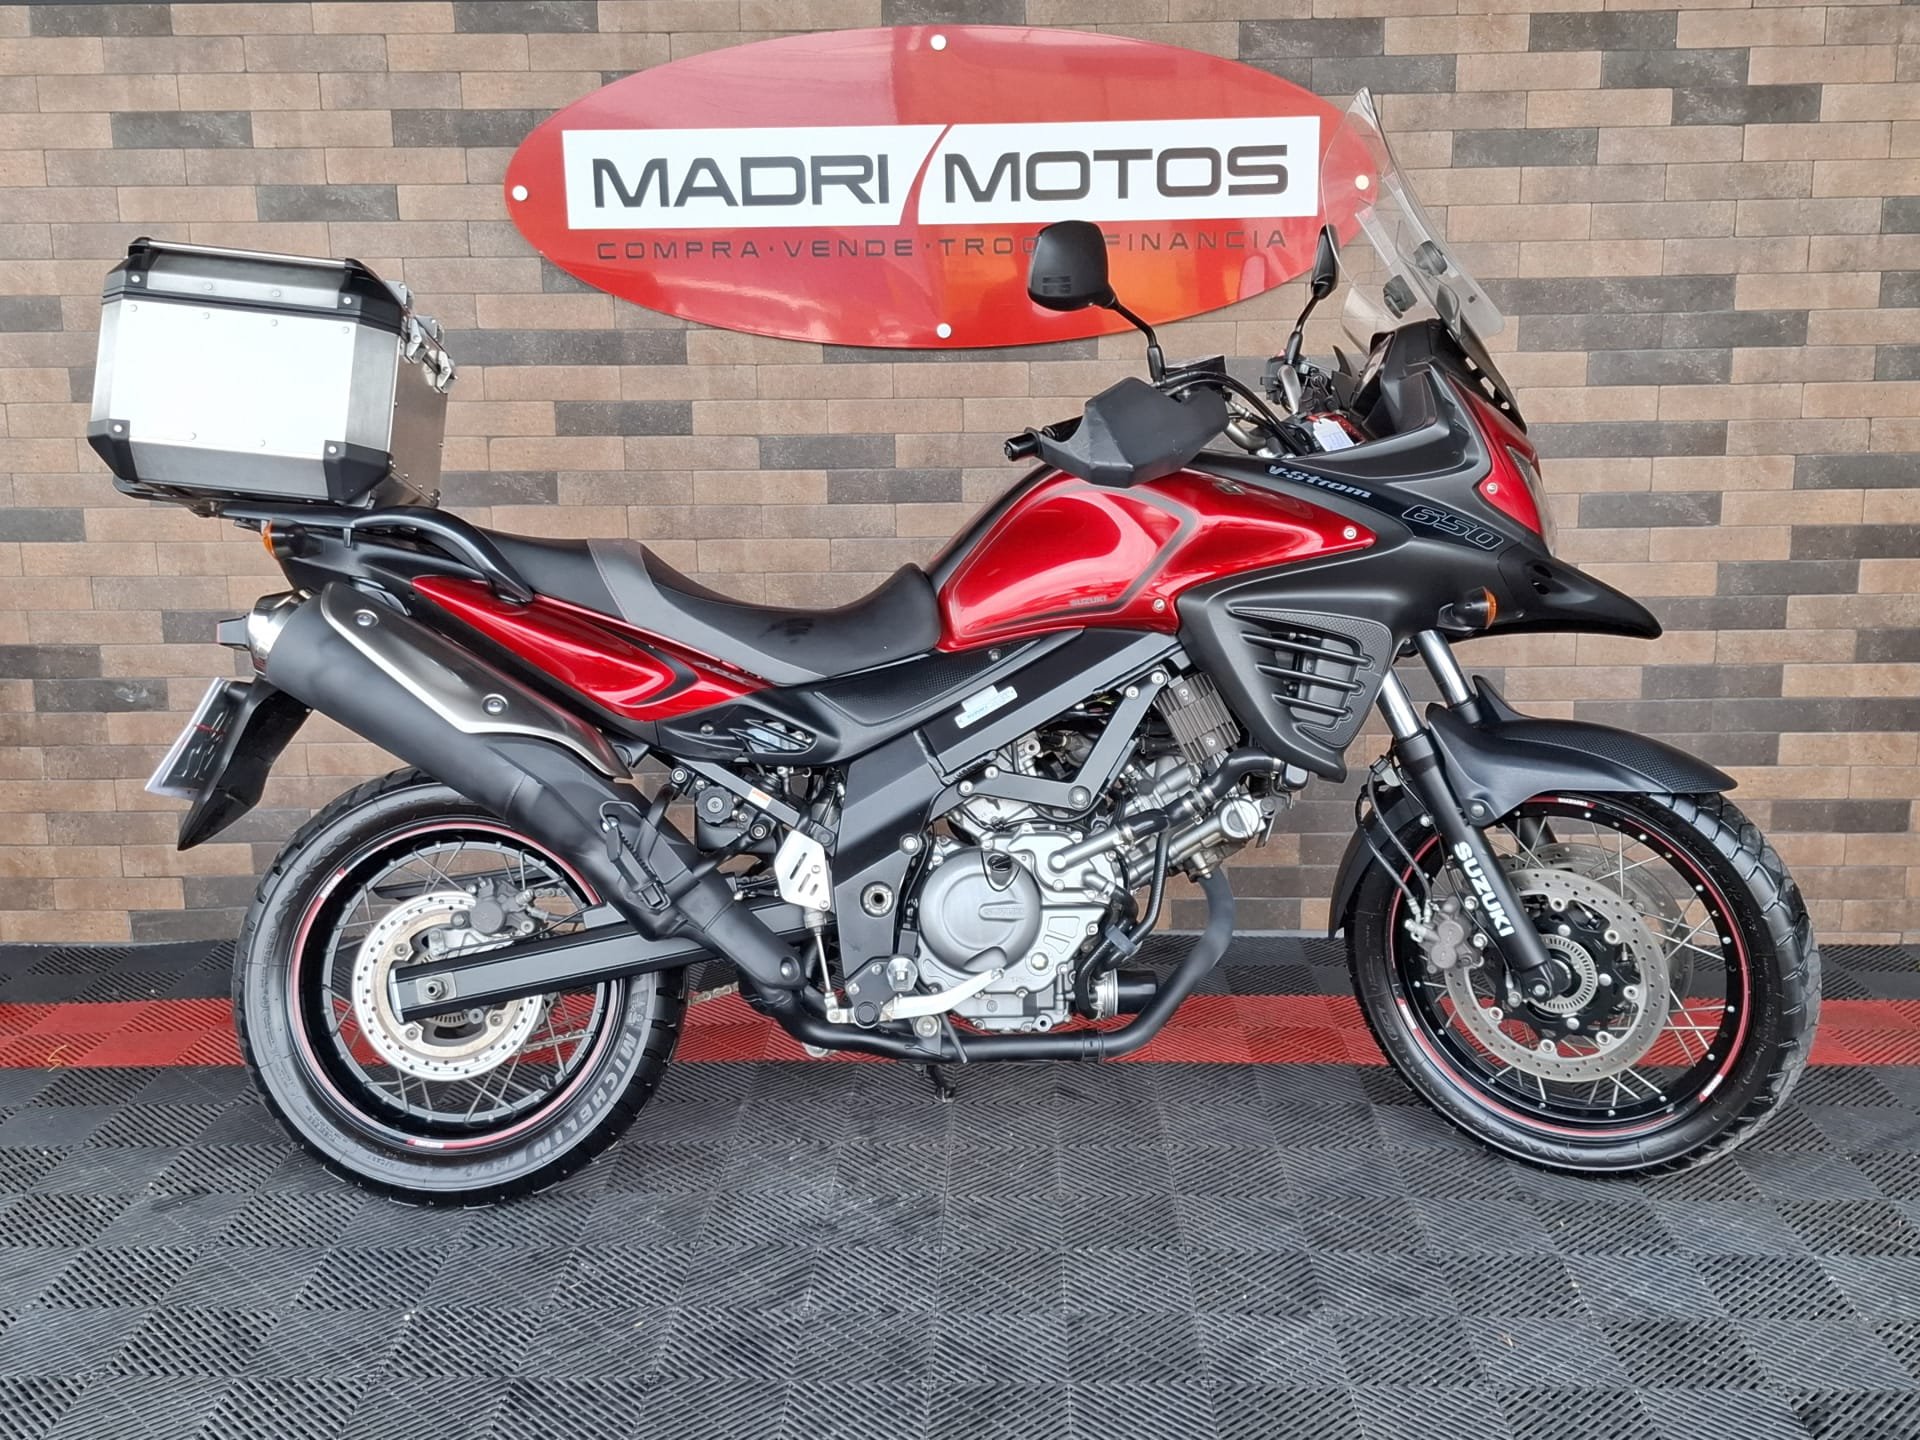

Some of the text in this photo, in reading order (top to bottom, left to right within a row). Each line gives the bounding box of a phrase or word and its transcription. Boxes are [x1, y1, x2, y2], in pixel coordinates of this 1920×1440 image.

[592, 144, 1289, 208] MADRI MOTOS
[597, 240, 760, 260] COMPRA
[783, 239, 913, 258] VENDE
[938, 236, 1040, 257] TROC
[1401, 503, 1504, 550] 650
[1454, 841, 1516, 937] SUZUKI
[532, 1032, 638, 1156] MICHELIN
